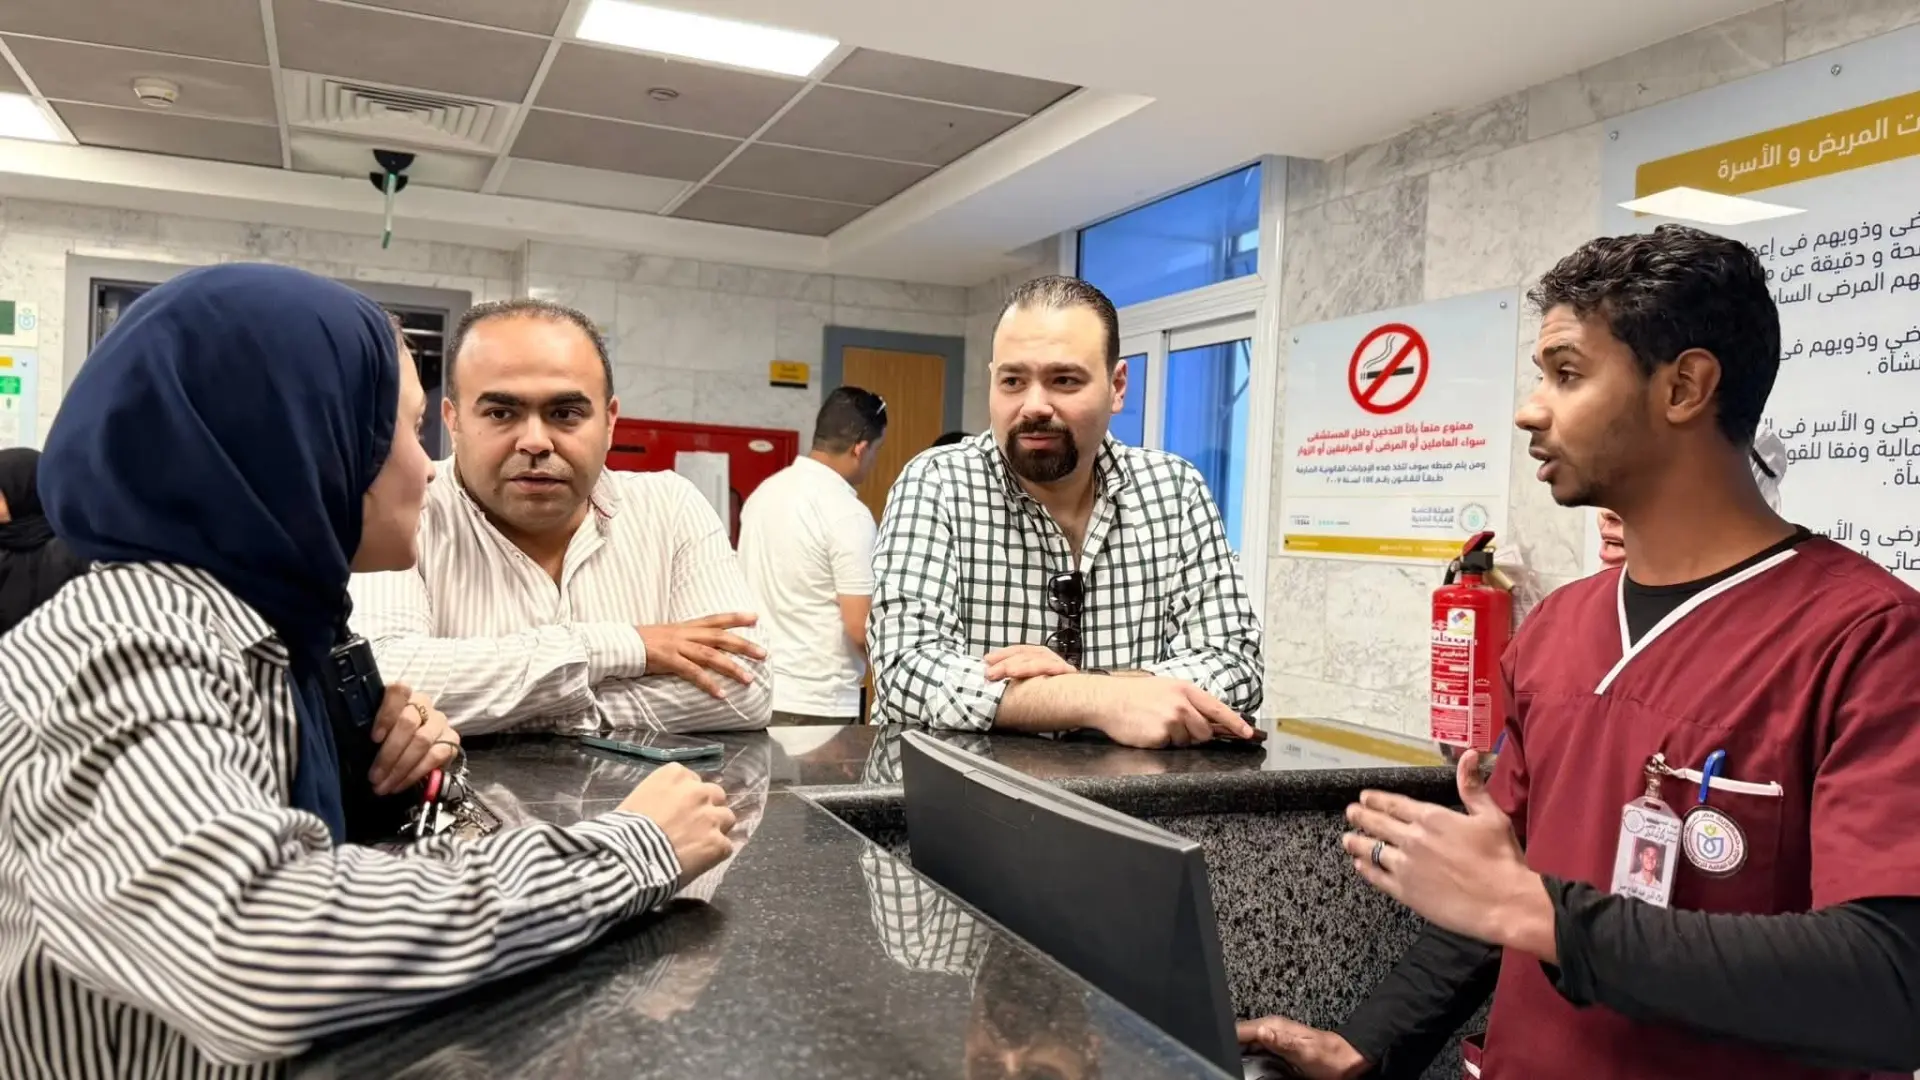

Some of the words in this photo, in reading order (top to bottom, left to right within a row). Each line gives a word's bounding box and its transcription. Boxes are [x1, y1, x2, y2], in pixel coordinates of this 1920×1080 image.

[1809, 117, 1889, 163] المريض
[1717, 143, 1782, 182] الأسرة
[1788, 147, 1801, 168] و
[1813, 221, 1882, 251] وذويهم
[1811, 252, 1865, 274] دقيقة
[1872, 250, 1883, 268] و
[1780, 264, 1805, 282] عن
[1817, 272, 1884, 303] المرضى
[1809, 331, 1878, 358] وذويهم
[1351, 428, 1371, 440] داخل
[1372, 424, 1404, 439] التدخين
[1442, 422, 1474, 434] ممنوع
[1812, 410, 1857, 437] الأسر
[1864, 417, 1875, 435] و
[1365, 439, 1374, 453] أو
[1409, 436, 1418, 451] أو
[1420, 437, 1458, 450] العاملين
[1460, 437, 1486, 448] سواء
[1785, 441, 1821, 465] للقو
[1828, 441, 1869, 463] وفقا
[1876, 438, 1920, 462] مالية
[1860, 528, 1870, 546] و
[1878, 525, 1920, 547] رضى
